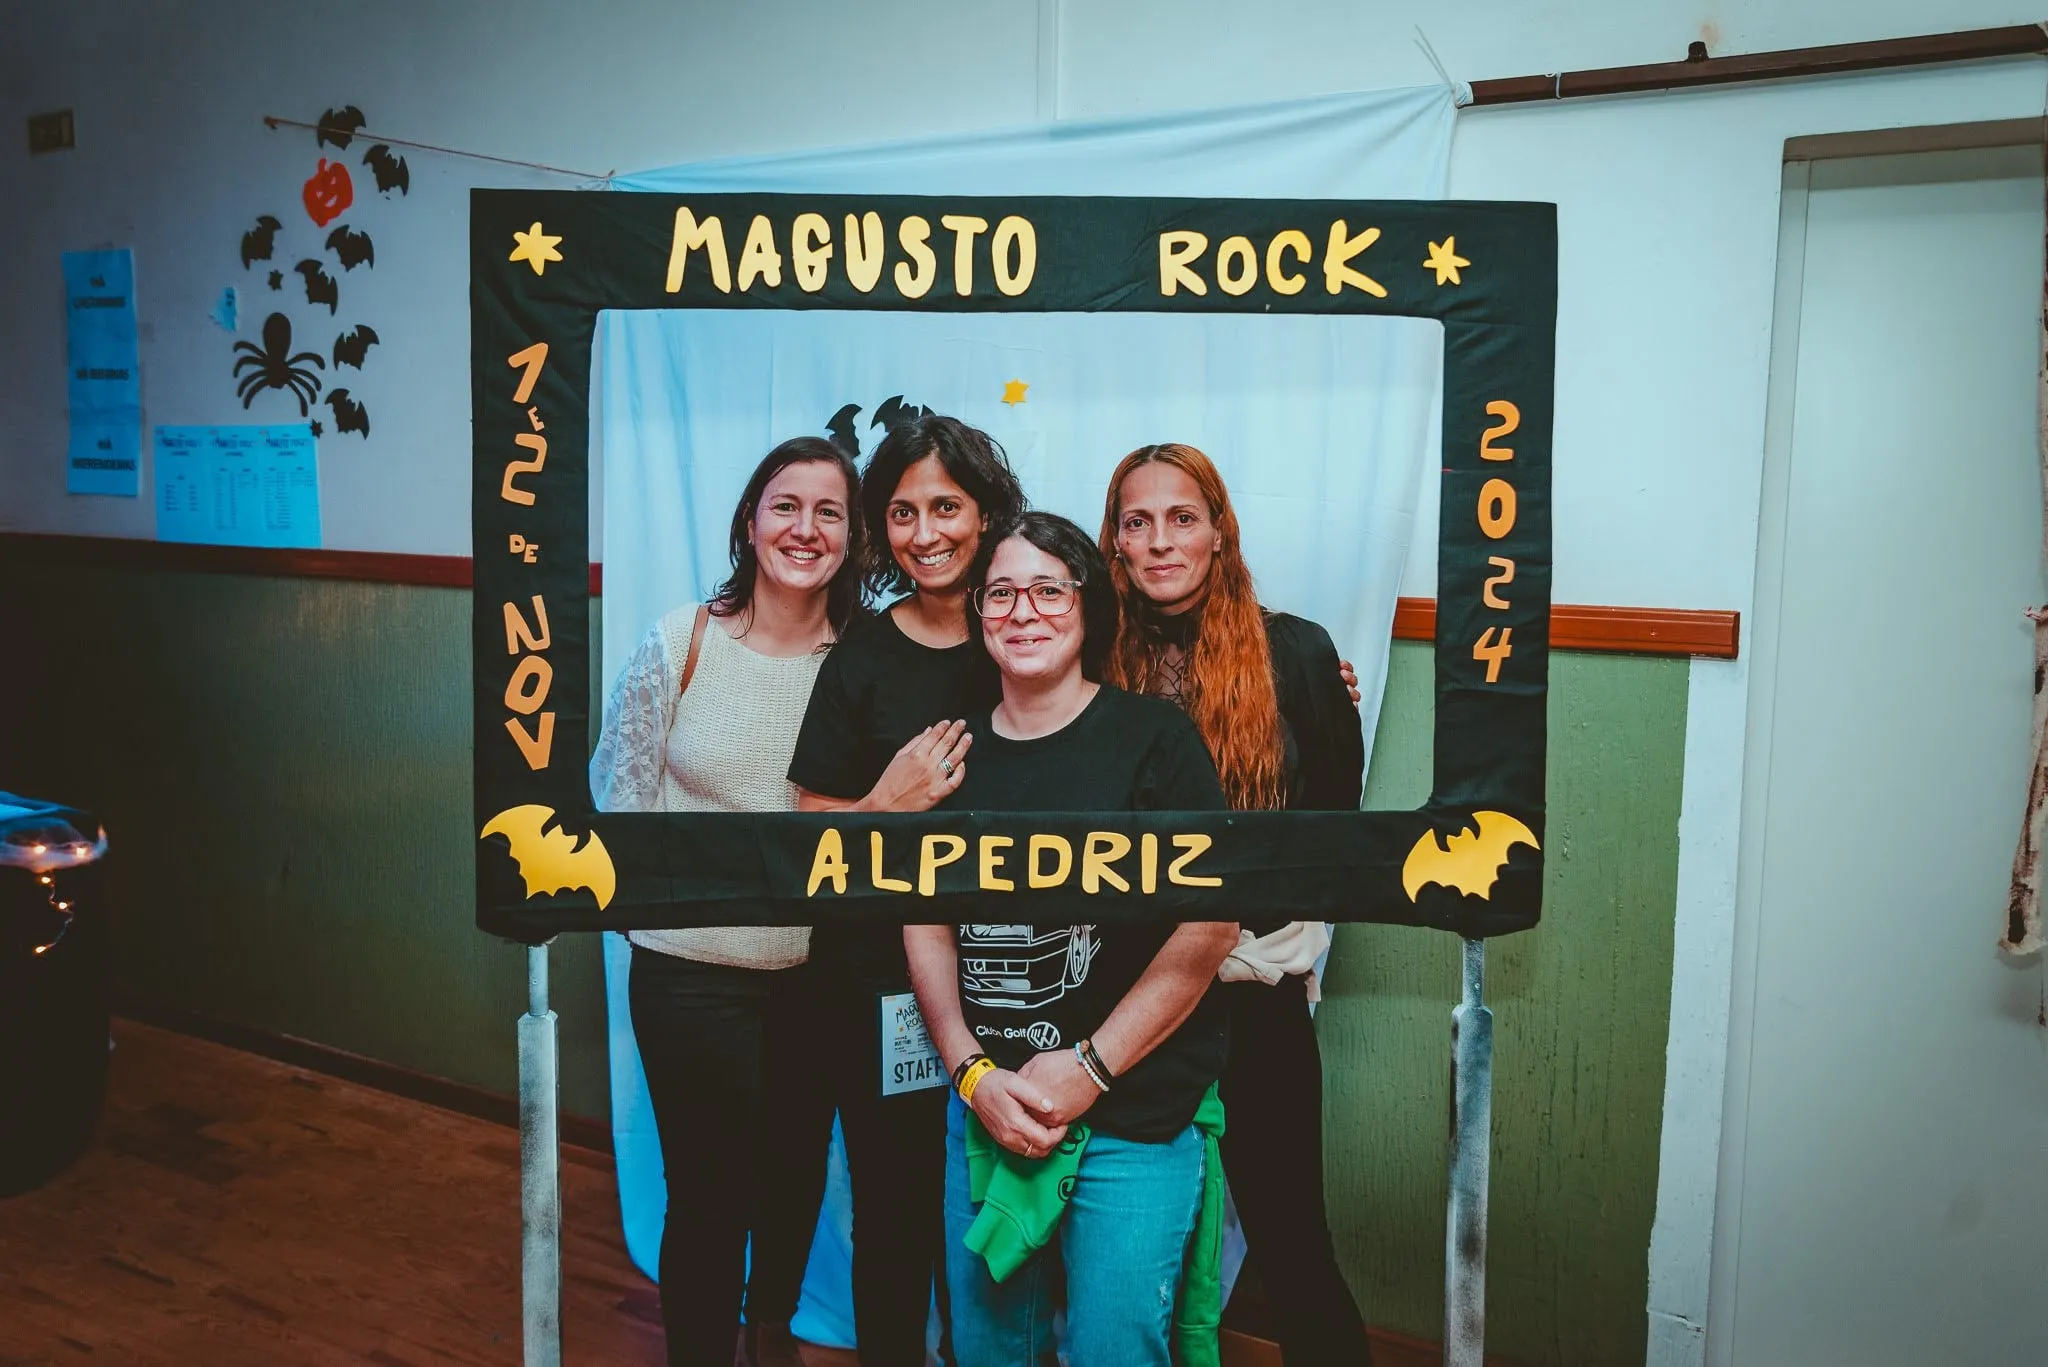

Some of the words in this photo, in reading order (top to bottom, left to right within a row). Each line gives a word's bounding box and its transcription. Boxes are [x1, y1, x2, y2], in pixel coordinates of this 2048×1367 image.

[664, 205, 1038, 299] MAGUSTO
[1160, 219, 1389, 299] ROCK
[507, 342, 549, 404] 1
[527, 405, 545, 432] E
[501, 432, 548, 506] 2
[509, 533, 539, 564] DE
[1471, 399, 1521, 684] 2024
[503, 594, 556, 771] NOV
[806, 828, 1224, 898] ALPEDRIZ
[894, 1056, 944, 1084] STAFF
